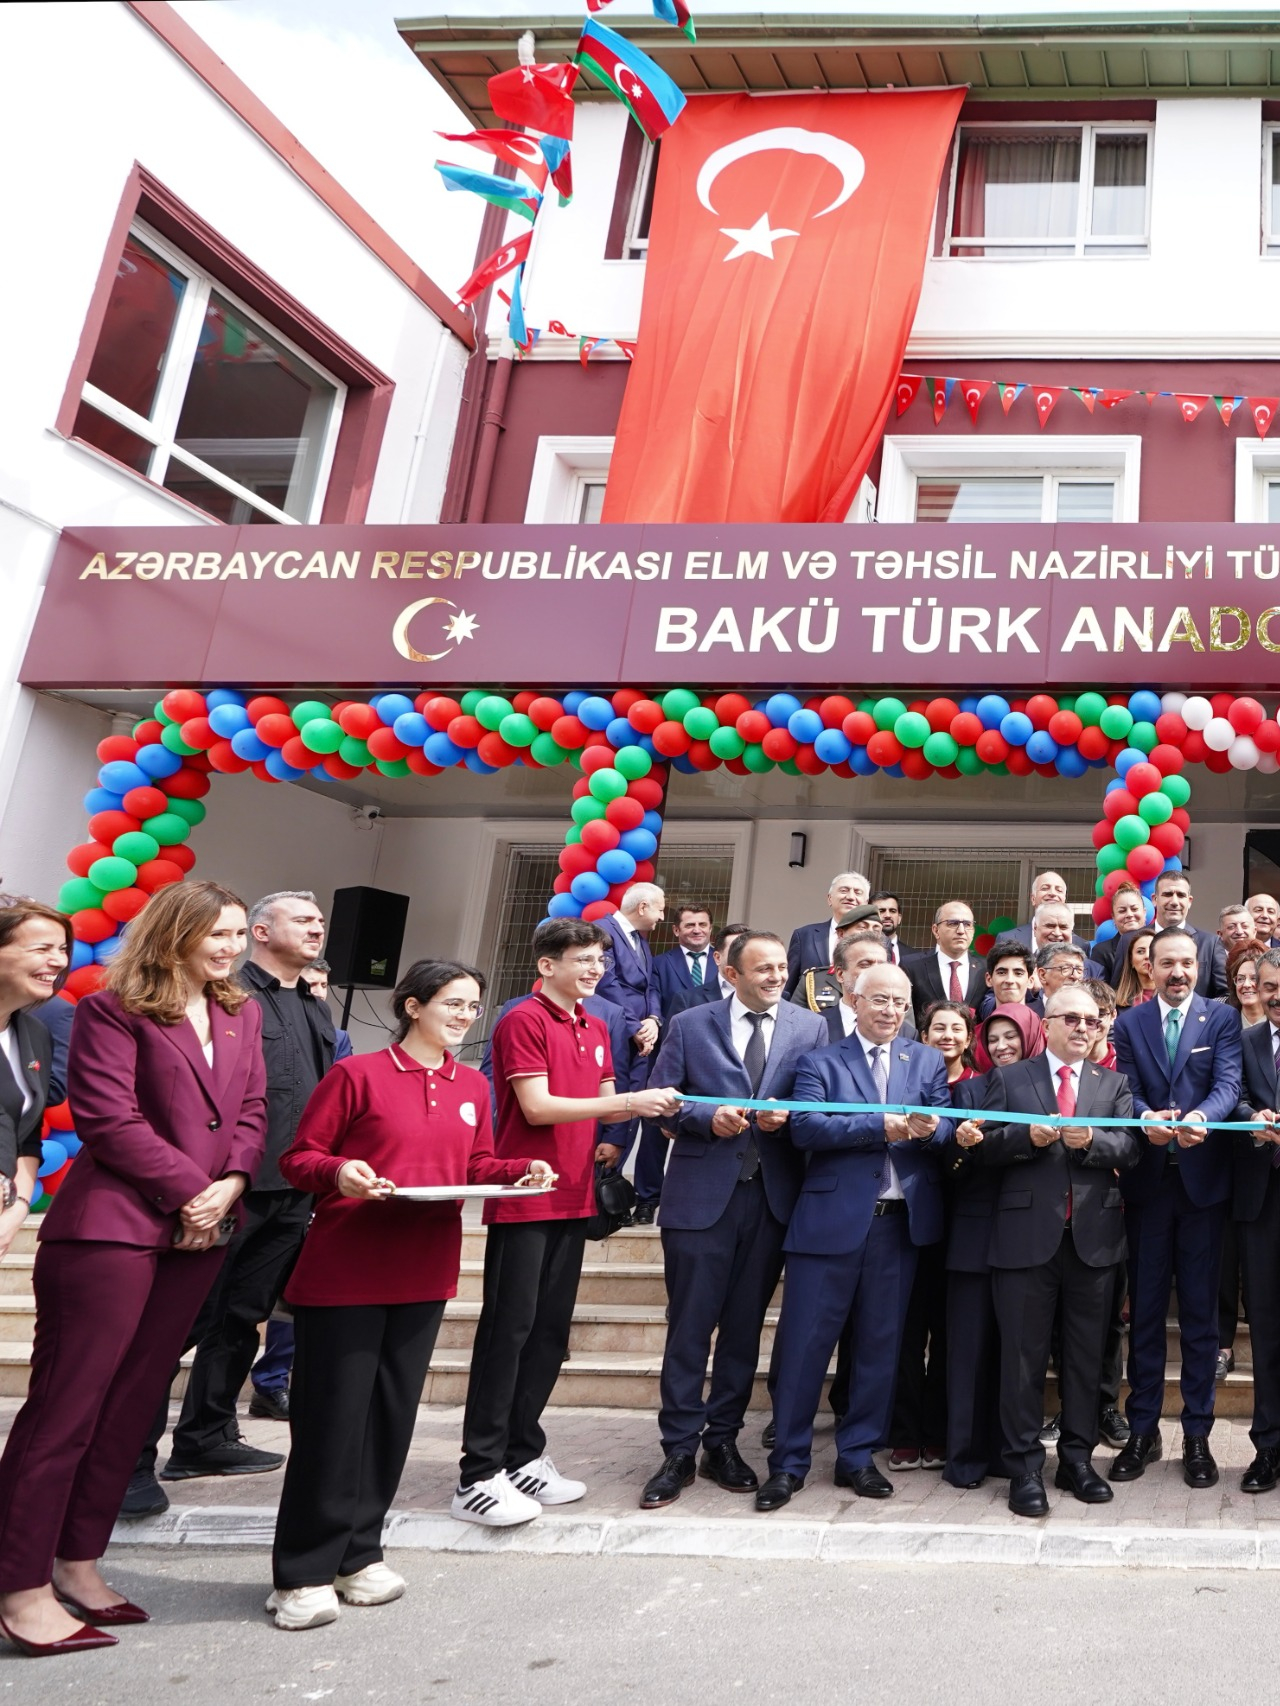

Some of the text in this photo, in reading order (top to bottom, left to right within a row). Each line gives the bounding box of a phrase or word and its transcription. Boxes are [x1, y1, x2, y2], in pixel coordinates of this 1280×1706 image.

[79, 551, 361, 580] AZƏRBAYCAN
[370, 545, 672, 580] RESPUBLİKASI
[684, 551, 769, 580] ELM
[782, 551, 837, 580] VƏ
[850, 544, 997, 580] TƏHSİL
[1009, 545, 1213, 580] NAZİRLİYİ
[655, 597, 839, 653] BAKÜ
[861, 597, 1041, 653] TÜRK
